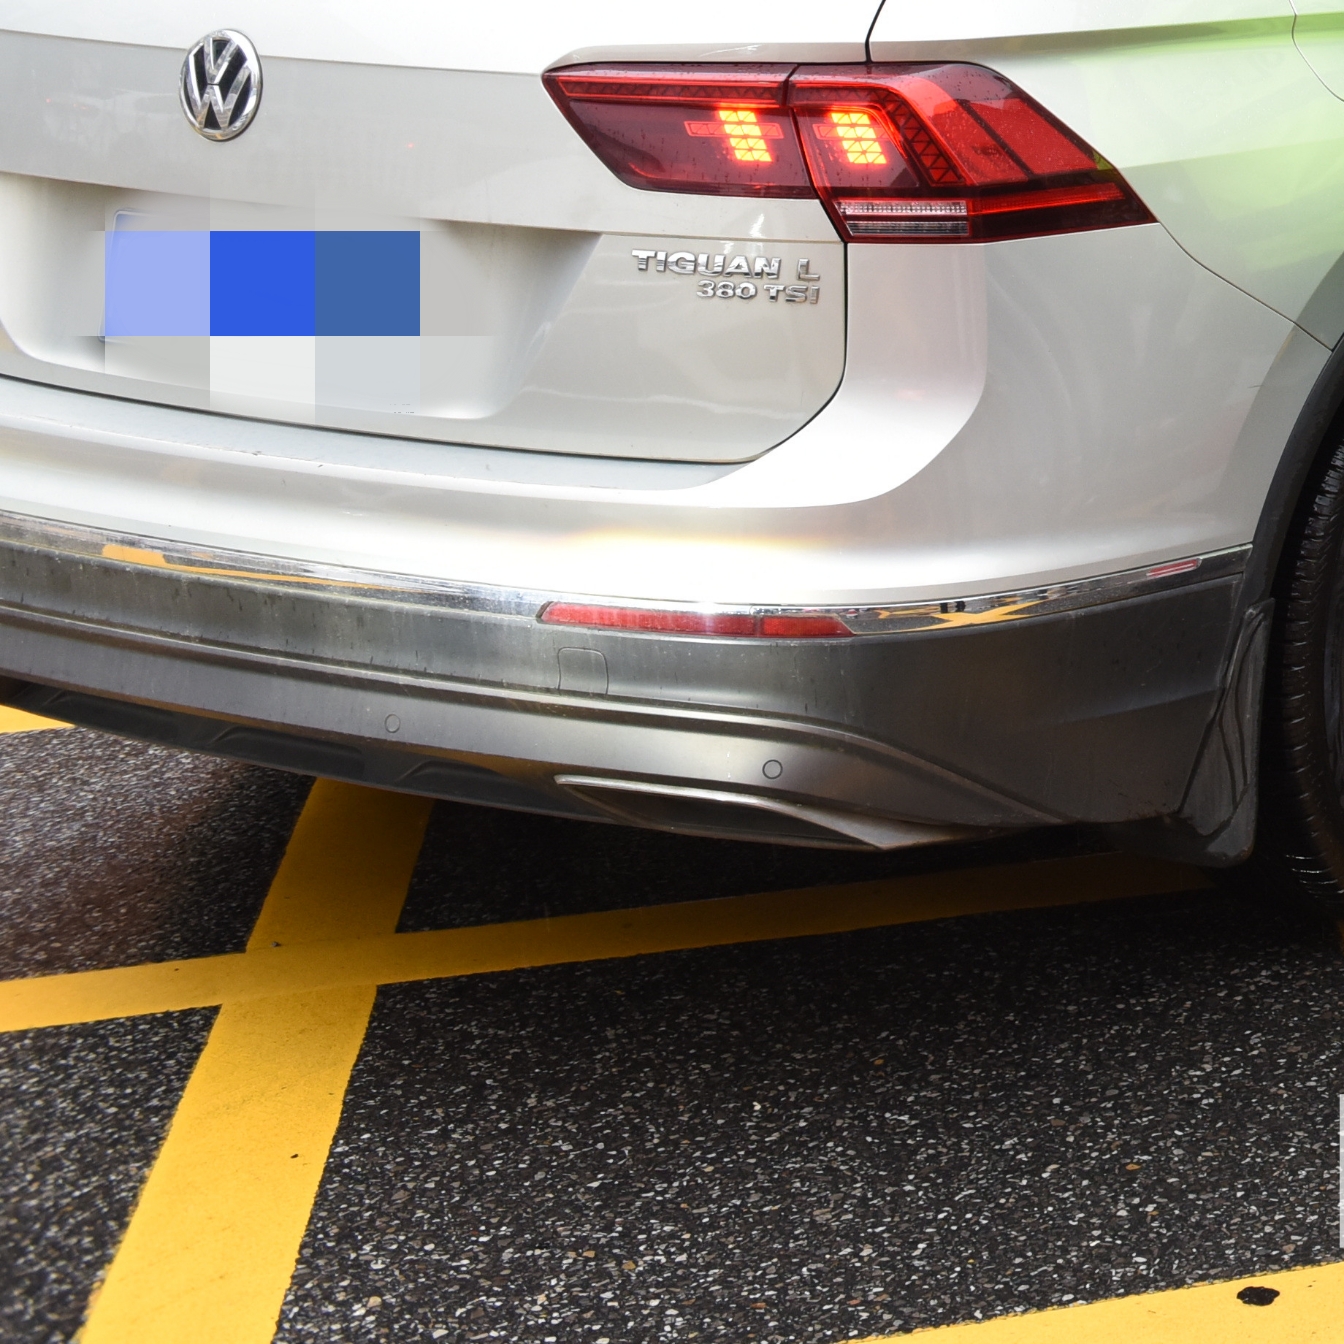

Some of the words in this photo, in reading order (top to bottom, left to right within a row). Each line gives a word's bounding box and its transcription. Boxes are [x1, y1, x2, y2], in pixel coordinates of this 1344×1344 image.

[631, 248, 782, 280] TIGUAN
[796, 257, 821, 281] L
[696, 279, 758, 300] 380
[763, 284, 821, 305] TSI
